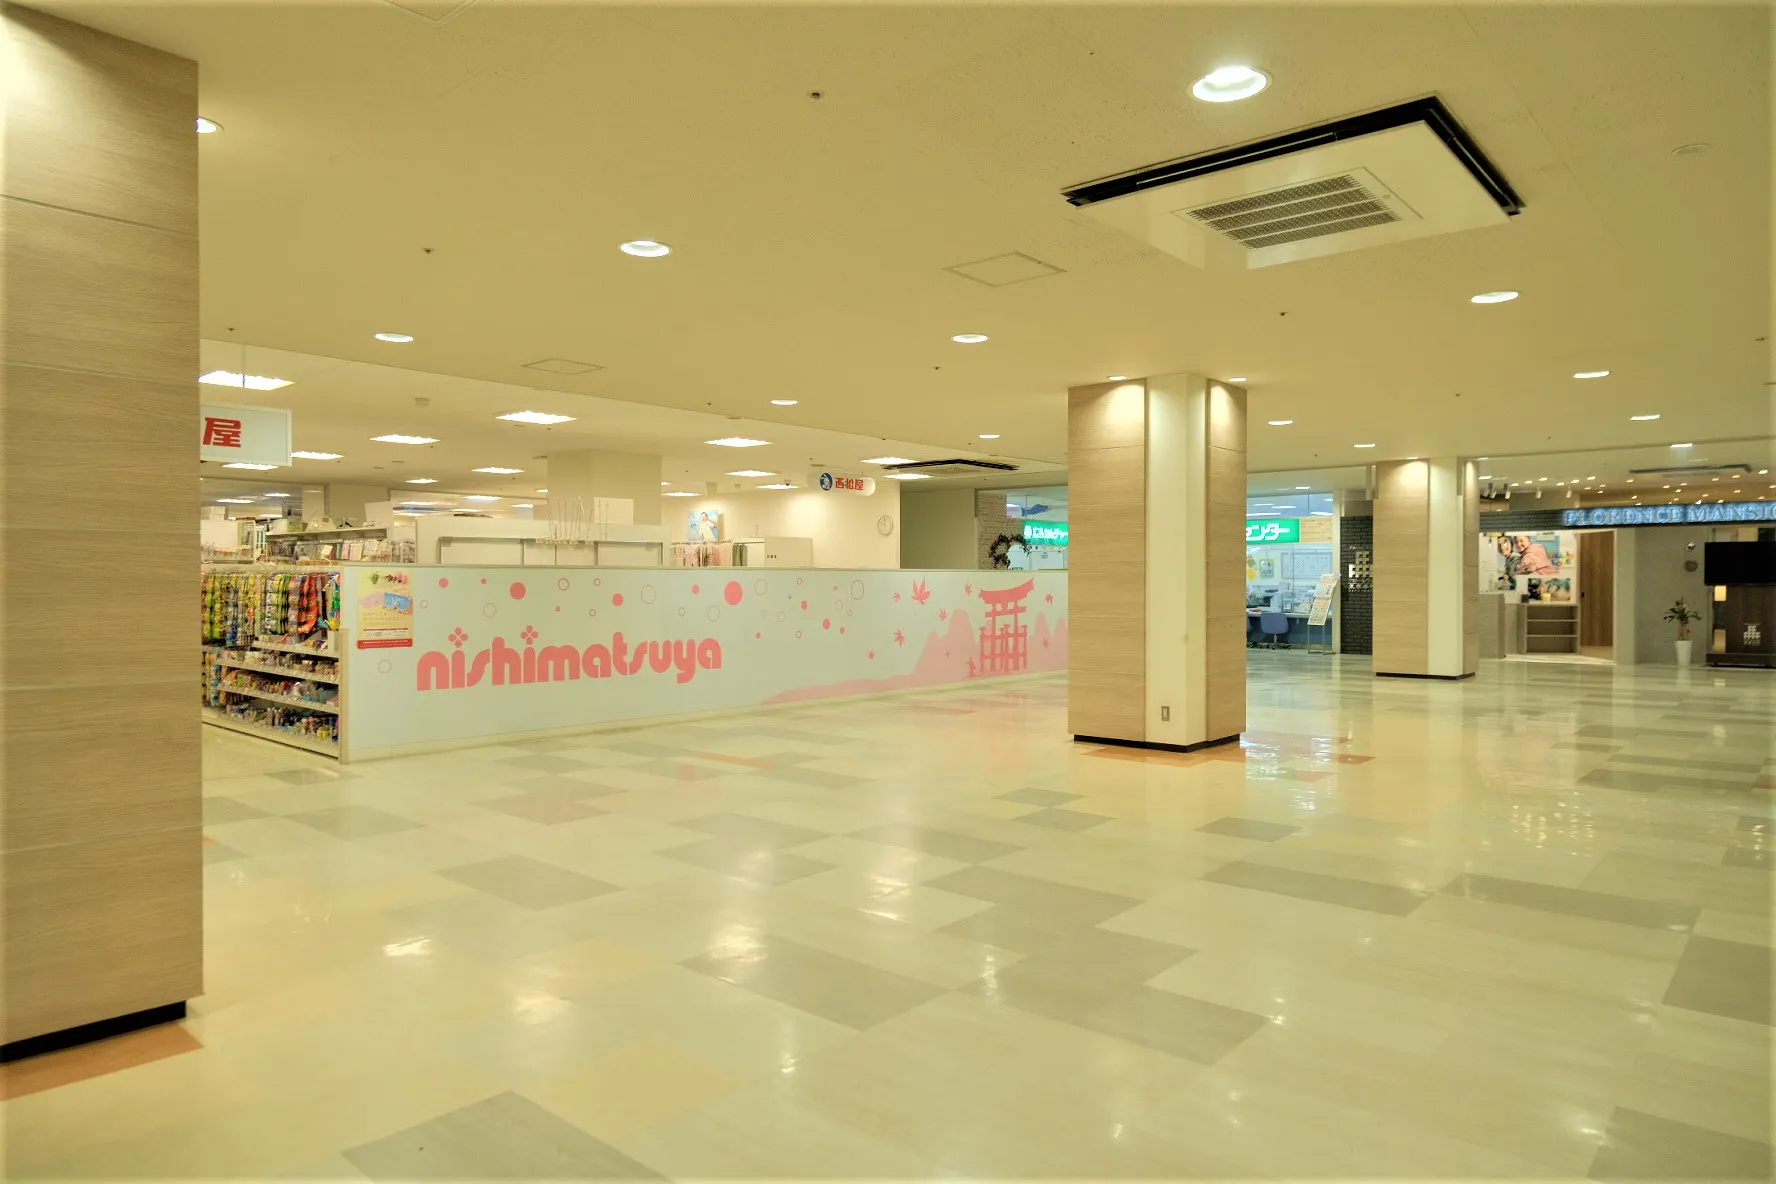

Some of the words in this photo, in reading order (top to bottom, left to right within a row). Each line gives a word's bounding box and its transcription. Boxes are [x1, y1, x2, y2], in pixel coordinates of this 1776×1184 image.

[835, 477, 864, 491] 西松屋
[1565, 505, 1683, 526] FLORENCE
[417, 625, 722, 692] nishimatsuya
